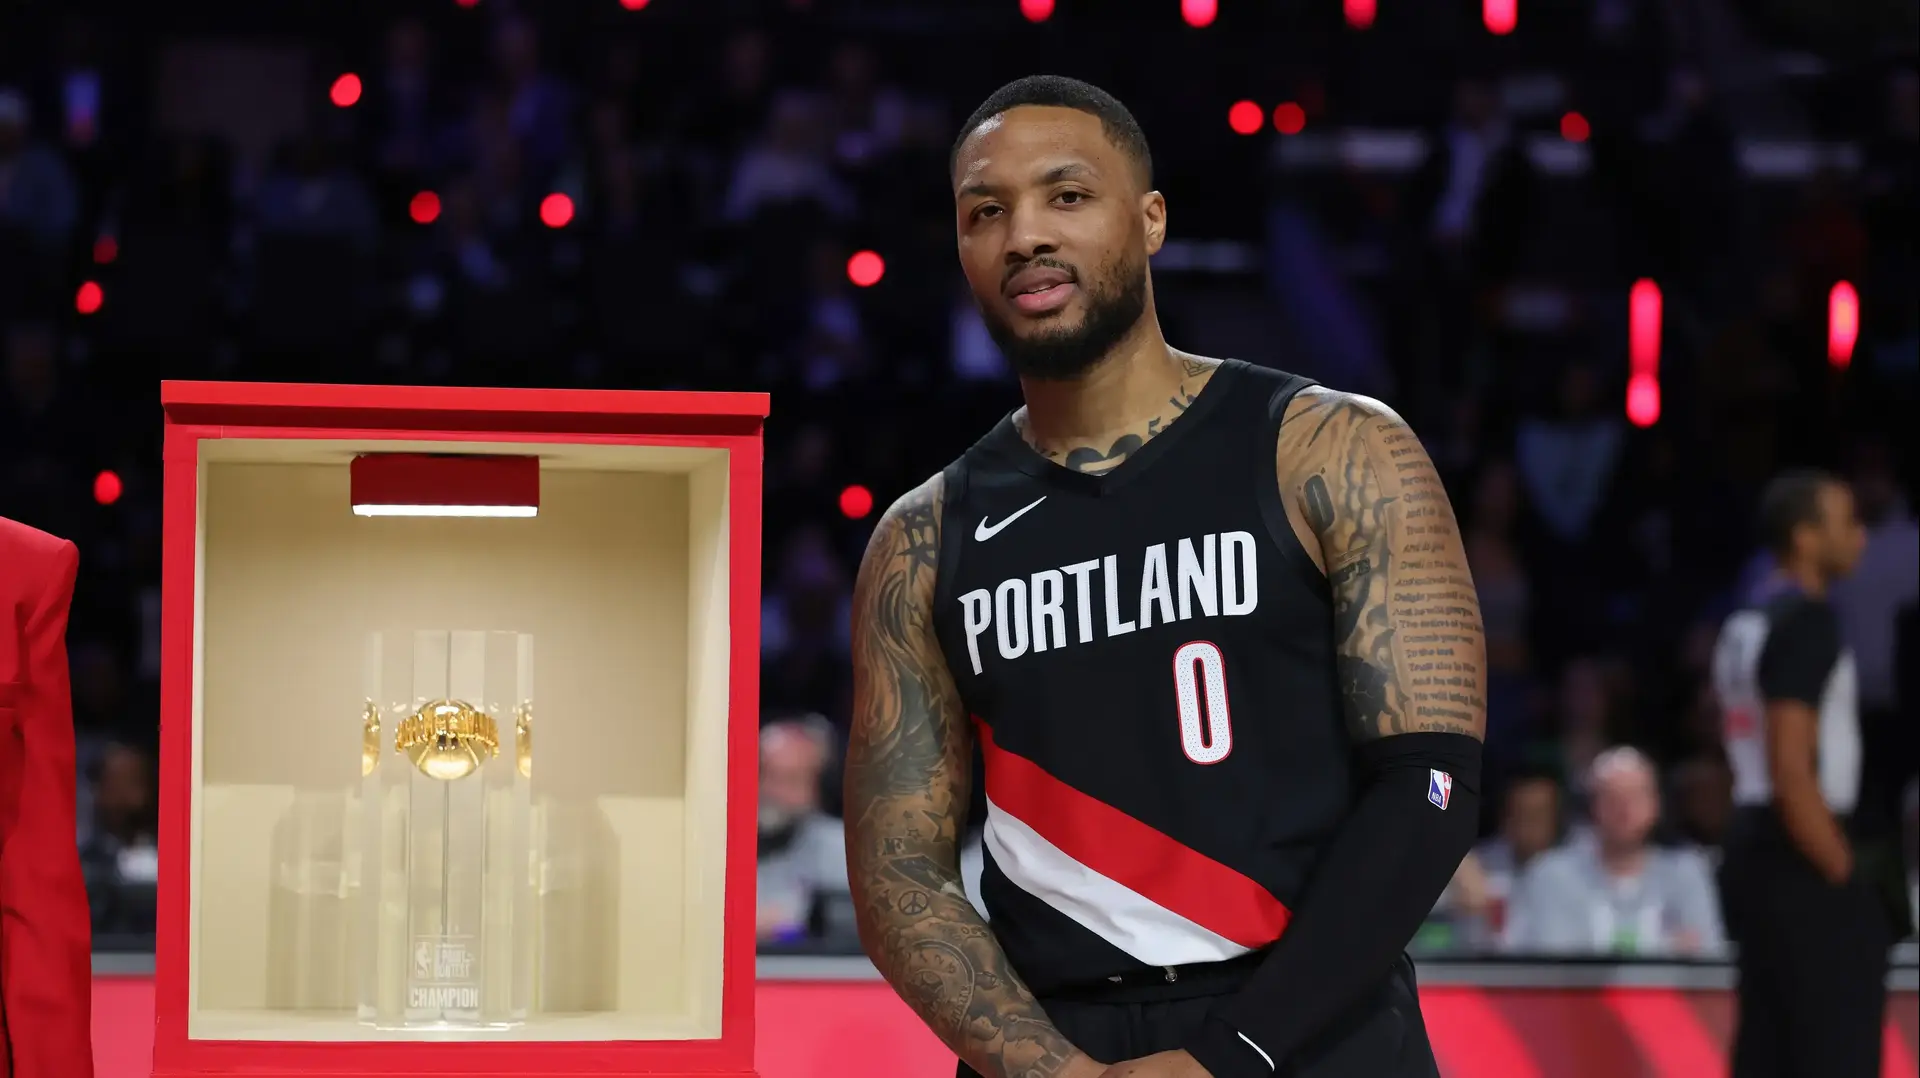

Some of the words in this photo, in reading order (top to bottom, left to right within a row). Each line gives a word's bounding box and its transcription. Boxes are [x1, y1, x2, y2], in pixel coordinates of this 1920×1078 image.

[957, 530, 1258, 676] PORTLAND
[1172, 640, 1233, 765] 0
[1430, 792, 1442, 804] NBA
[410, 987, 479, 1008] CHAMPION
